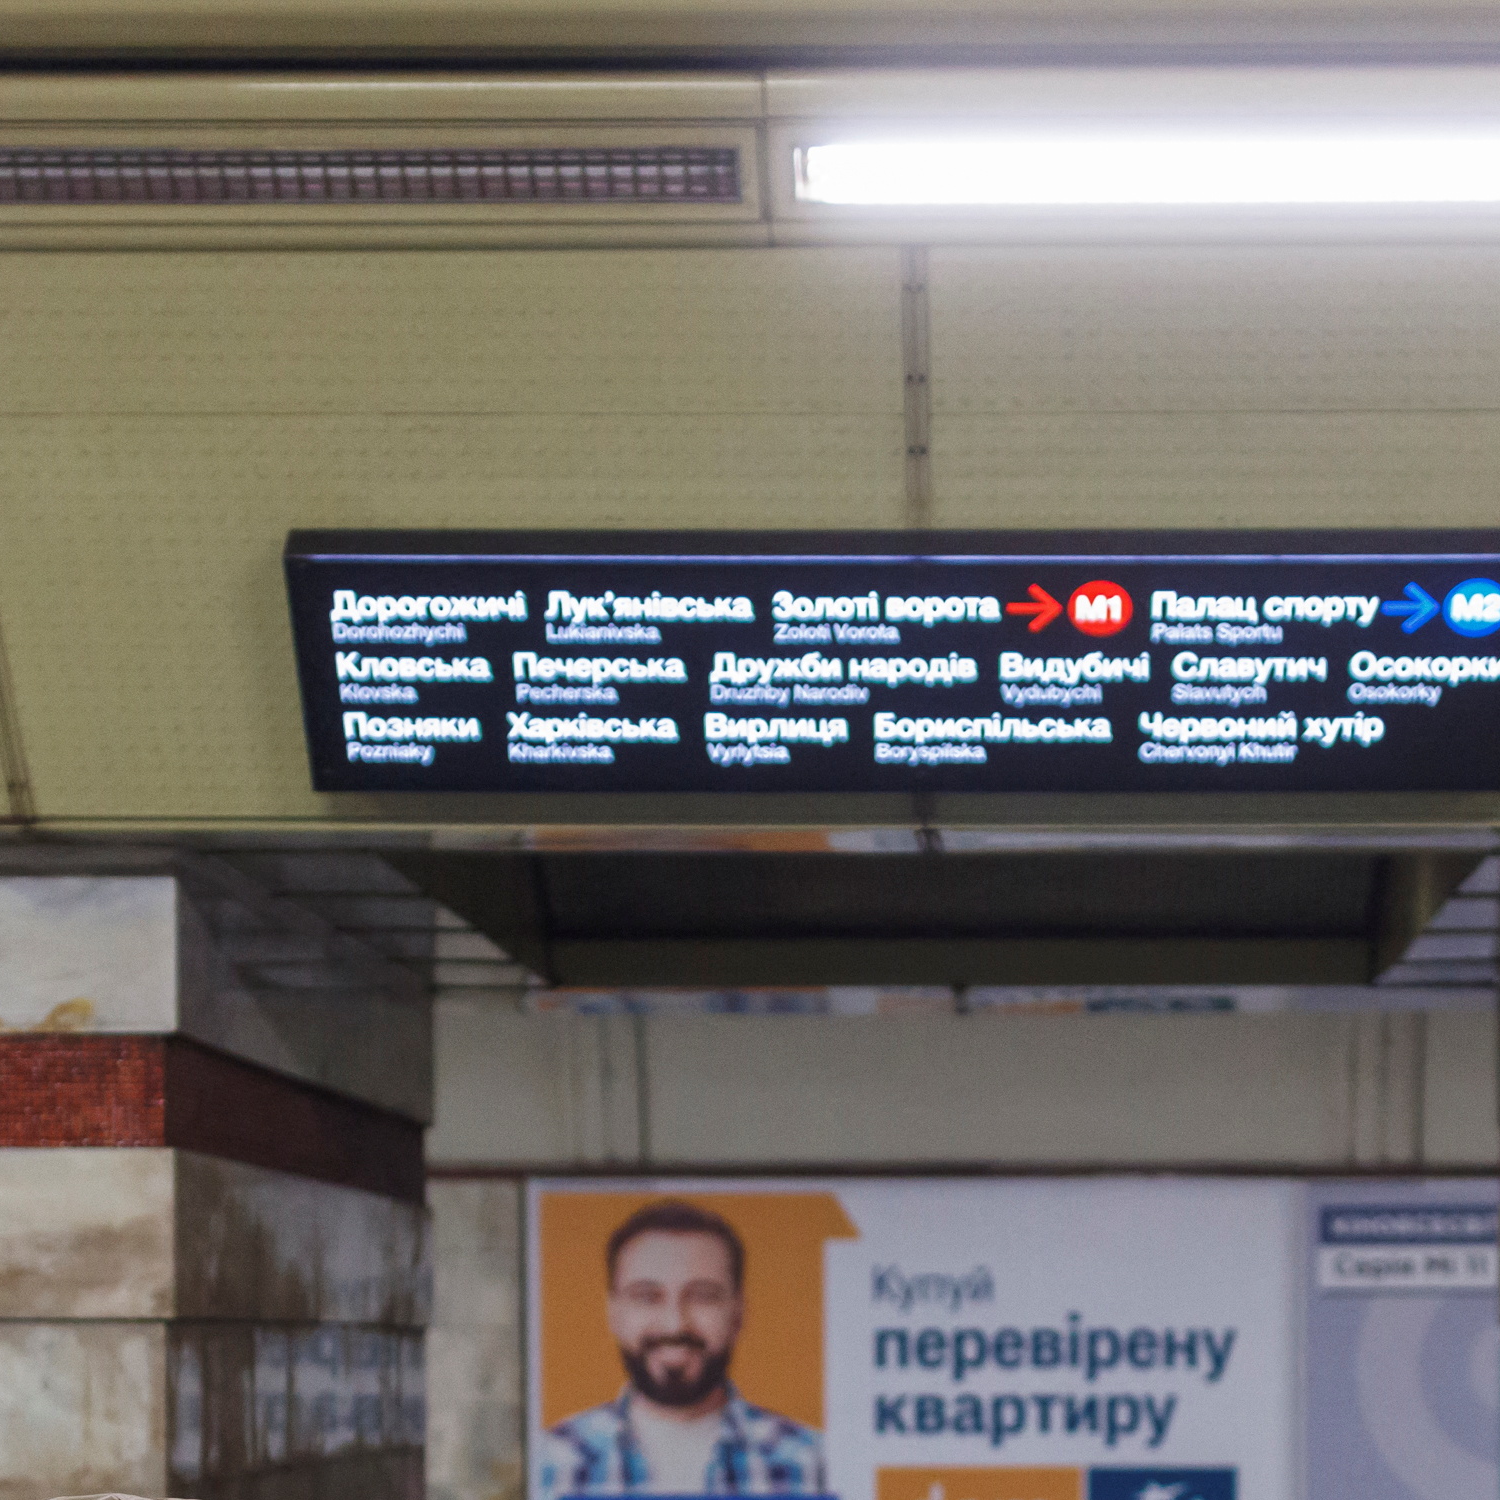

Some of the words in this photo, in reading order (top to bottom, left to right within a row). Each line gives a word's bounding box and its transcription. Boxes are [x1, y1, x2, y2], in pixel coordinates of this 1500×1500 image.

[330, 589, 528, 624] Дорогожичі
[543, 589, 755, 624] Лук'янівська
[772, 589, 880, 623] Золоті
[884, 594, 1001, 628] ворота
[1150, 589, 1259, 625] Палац
[1262, 595, 1380, 628] спорту
[833, 622, 900, 645] Vorota
[1150, 622, 1213, 645] Palats
[1215, 622, 1283, 646] Sportu
[335, 651, 494, 683] Кловська
[512, 651, 688, 684] Печерська
[708, 651, 843, 685] Дружби
[848, 651, 979, 688] народів
[998, 651, 1151, 686] Видубичі
[1170, 651, 1328, 685] Славутич
[339, 682, 419, 704] Klovska
[342, 711, 482, 742] Позняки
[506, 711, 681, 743] Харківська
[703, 711, 849, 746] Вирлиця
[873, 711, 1114, 744] Бориспільська
[1137, 710, 1298, 744] Червоний
[1300, 711, 1385, 748] хутір
[872, 1265, 996, 1313] Купуй
[874, 1311, 1238, 1382] перевірену
[874, 1393, 1178, 1449] квартиру
